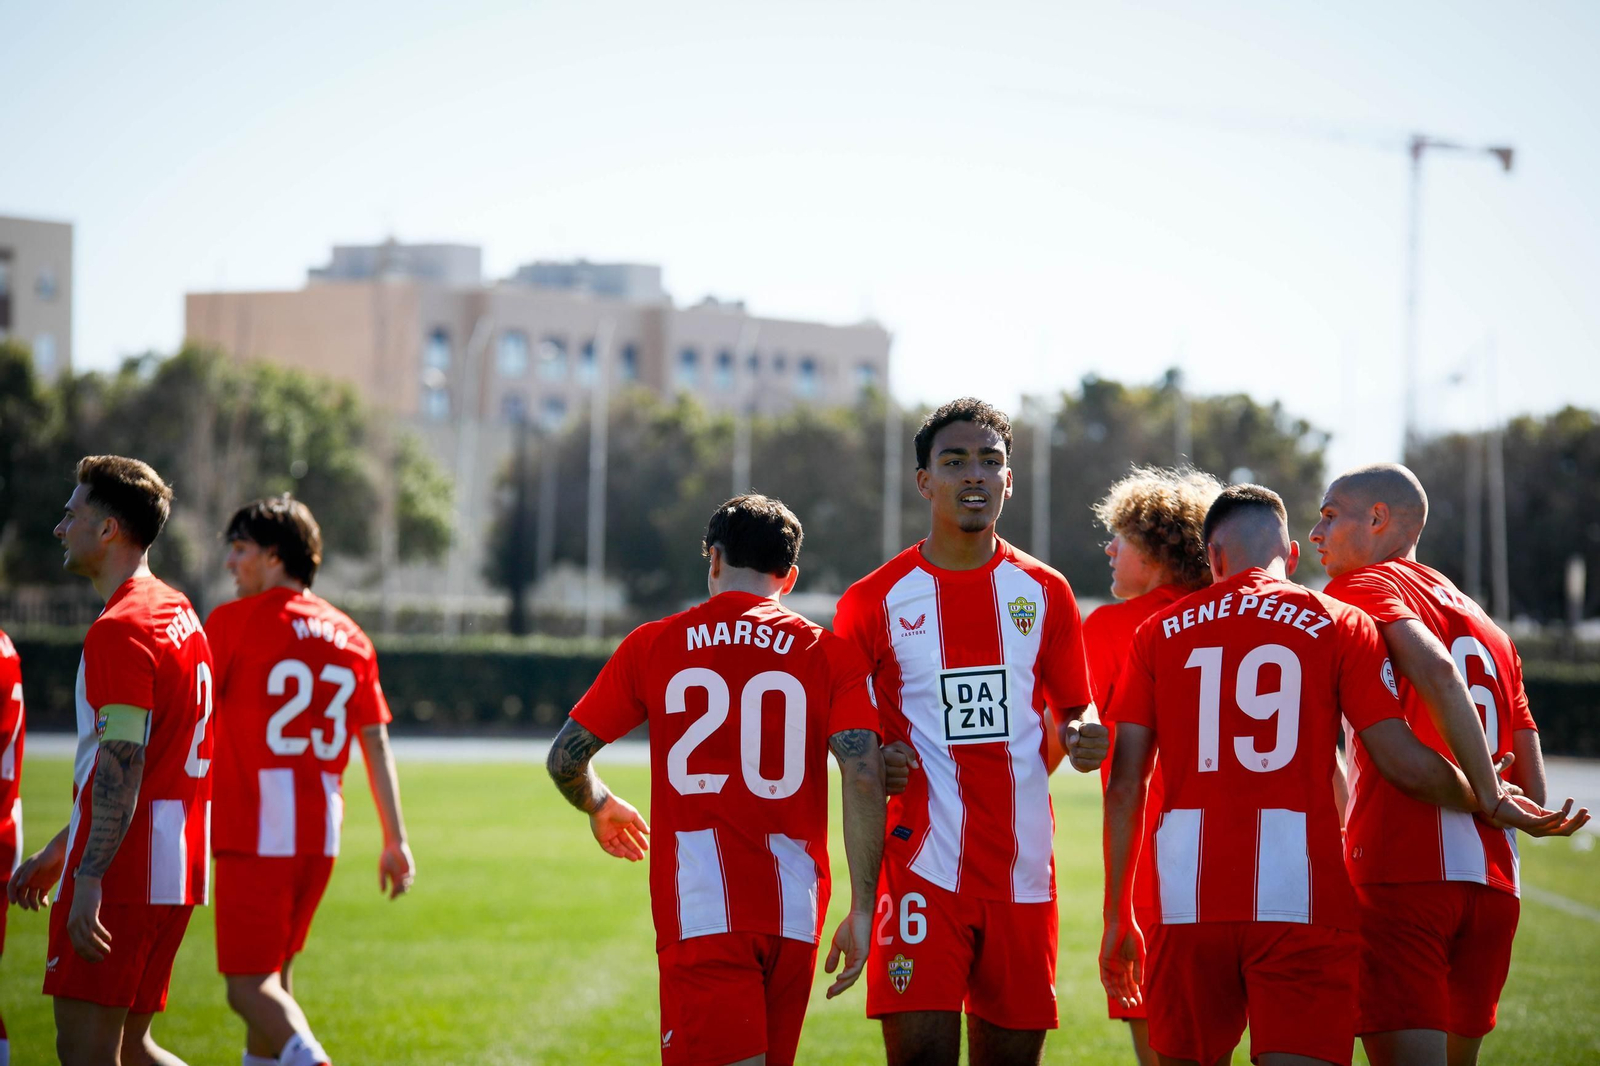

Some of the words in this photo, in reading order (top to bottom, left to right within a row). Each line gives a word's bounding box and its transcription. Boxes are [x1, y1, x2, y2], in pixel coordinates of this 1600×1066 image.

[687, 620, 795, 655] MARSU
[901, 630, 926, 638] CASTORE
[1162, 593, 1233, 639] RENÉ
[1237, 593, 1333, 639] PÉREZ
[266, 659, 355, 760] 23
[957, 682, 993, 703] DA
[960, 706, 994, 729] ZN
[1184, 644, 1302, 773] 19
[184, 661, 213, 778] 2
[665, 667, 807, 800] 20
[876, 891, 927, 946] 26
